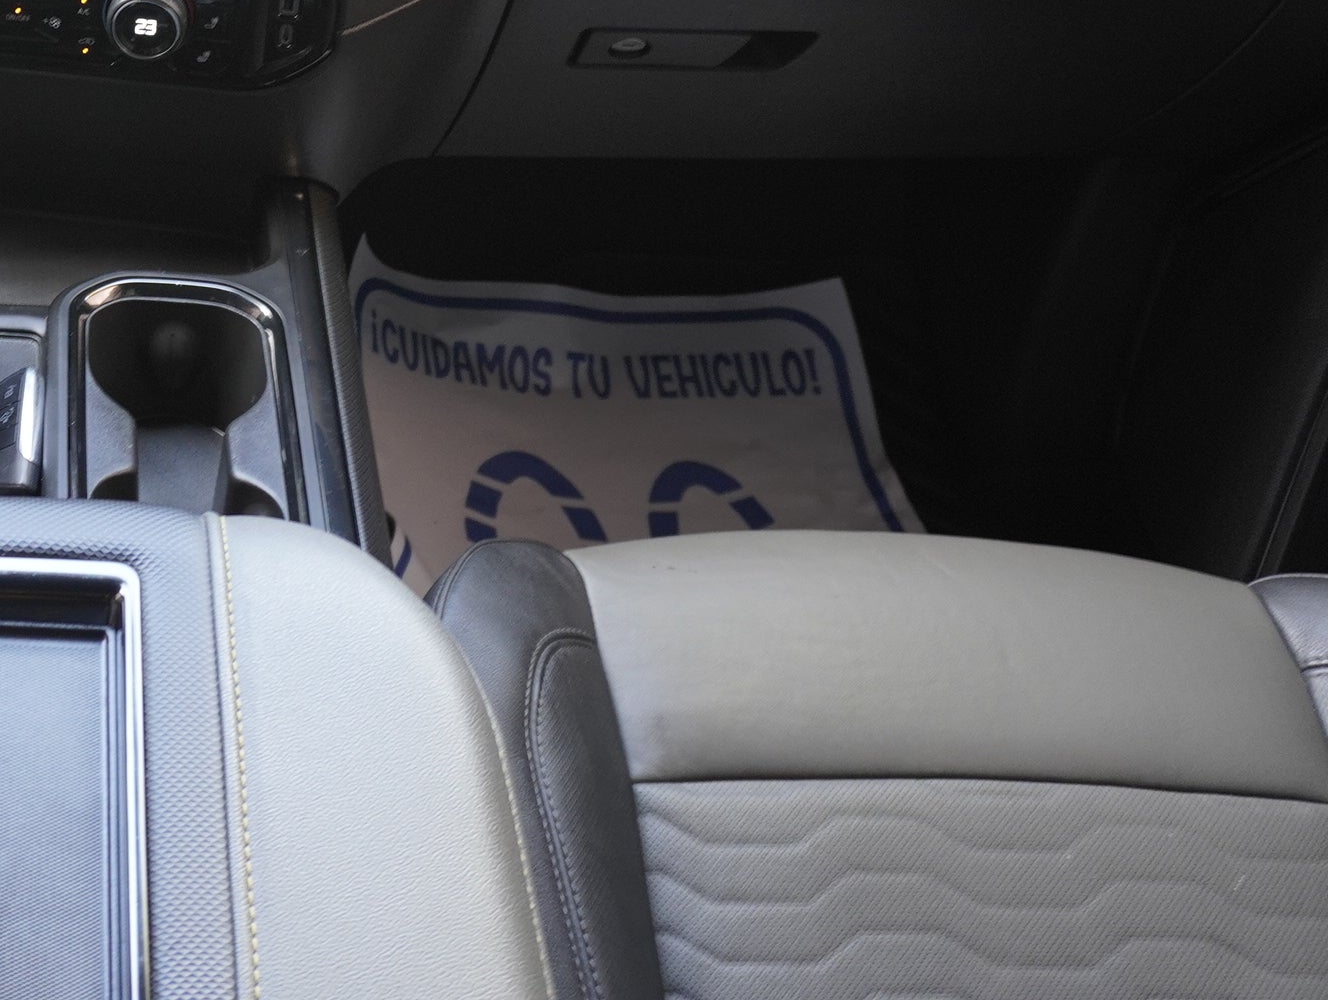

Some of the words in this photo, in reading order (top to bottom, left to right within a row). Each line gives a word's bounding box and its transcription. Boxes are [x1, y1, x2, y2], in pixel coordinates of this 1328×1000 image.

[134, 18, 158, 36] 23
[372, 309, 554, 398] ¡CUIDAMOS
[566, 350, 611, 400] TU
[623, 347, 822, 400] VEHICULO!
